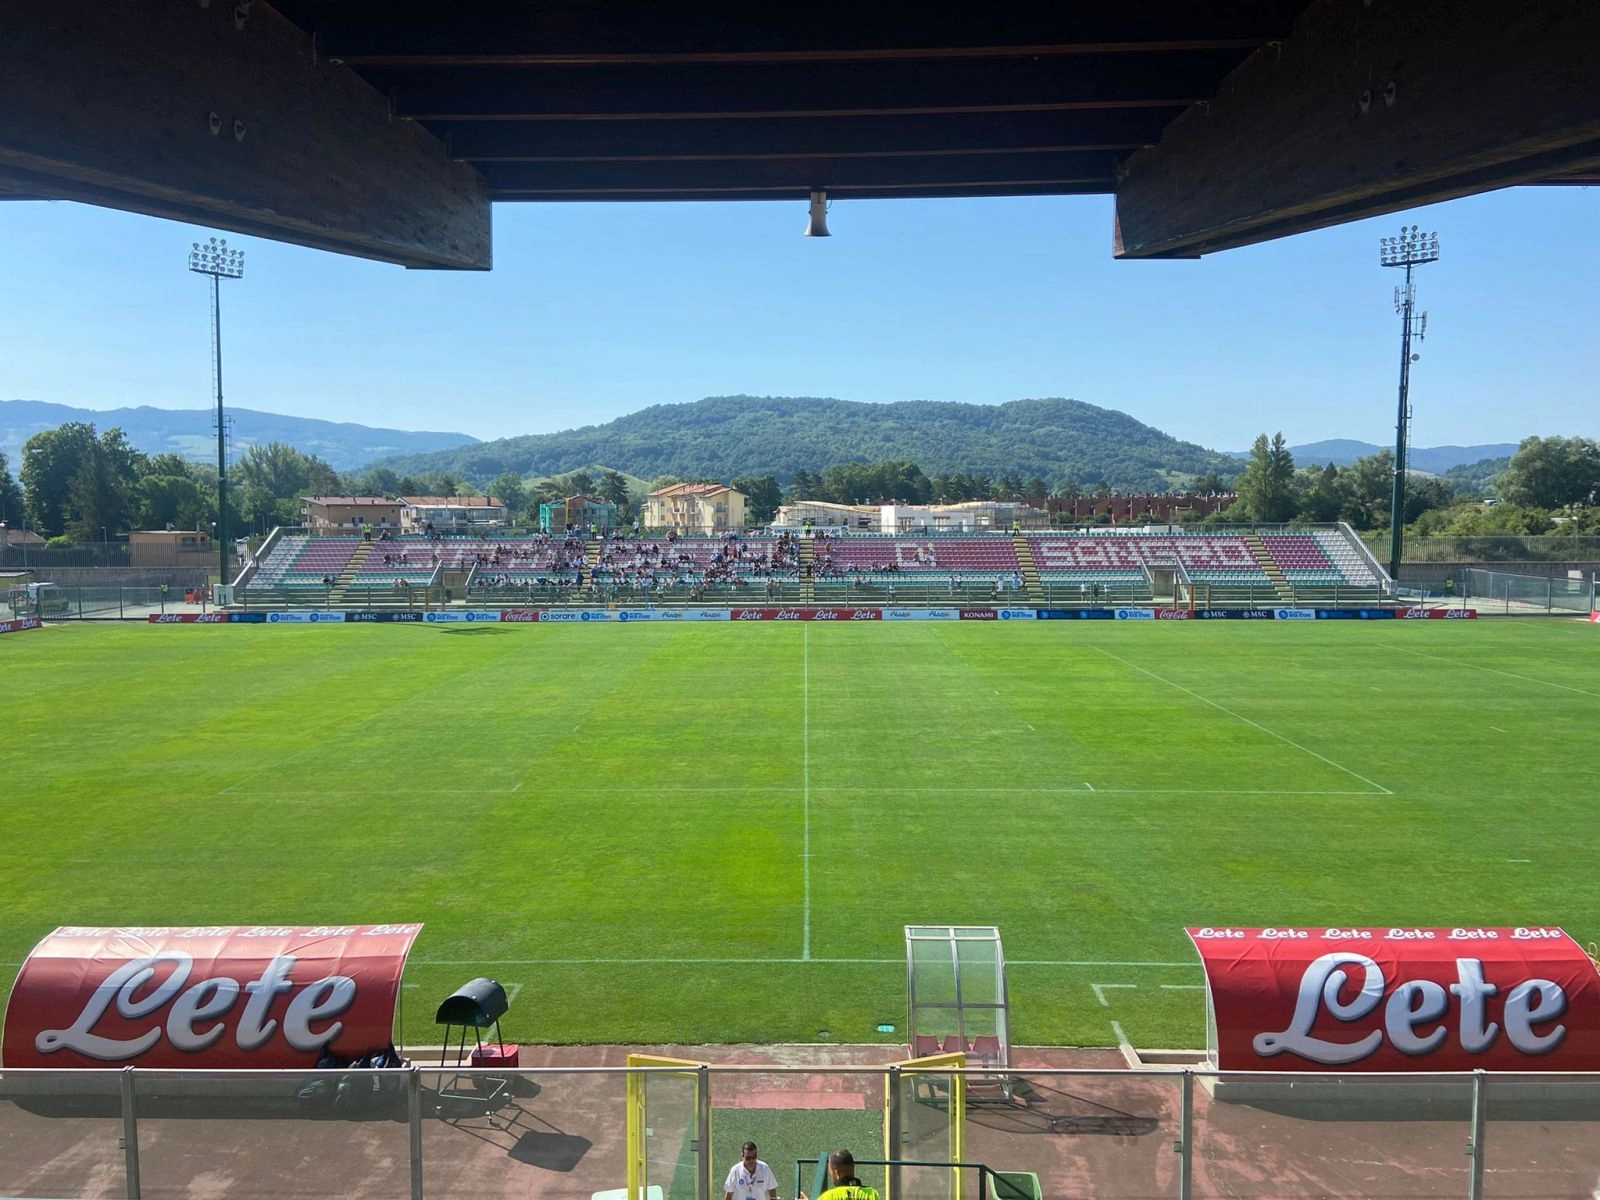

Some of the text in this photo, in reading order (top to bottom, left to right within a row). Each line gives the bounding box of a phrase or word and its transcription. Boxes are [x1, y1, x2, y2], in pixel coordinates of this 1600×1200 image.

[155, 614, 182, 622] Lete
[194, 614, 221, 622] Lete
[551, 611, 576, 619] sorare
[737, 610, 762, 620] Lete
[775, 610, 800, 620] Lete
[812, 610, 838, 620] Lete
[851, 610, 876, 620] Lete
[1210, 610, 1227, 618] MSC
[1250, 610, 1267, 618] MSC
[1403, 608, 1431, 618] Lete
[1443, 608, 1470, 618] Lete
[176, 927, 231, 938] Lete
[236, 926, 292, 937] Lete
[299, 926, 355, 937] Lete
[361, 924, 416, 936] Lete
[1193, 927, 1246, 939] Lete
[1256, 927, 1309, 939] Lete
[1320, 927, 1373, 939] Lete
[1383, 927, 1436, 939] Lete
[1447, 927, 1499, 939] Lete
[1509, 927, 1562, 939] Lete
[35, 950, 358, 1061] Lete
[1252, 951, 1568, 1065] Lete
